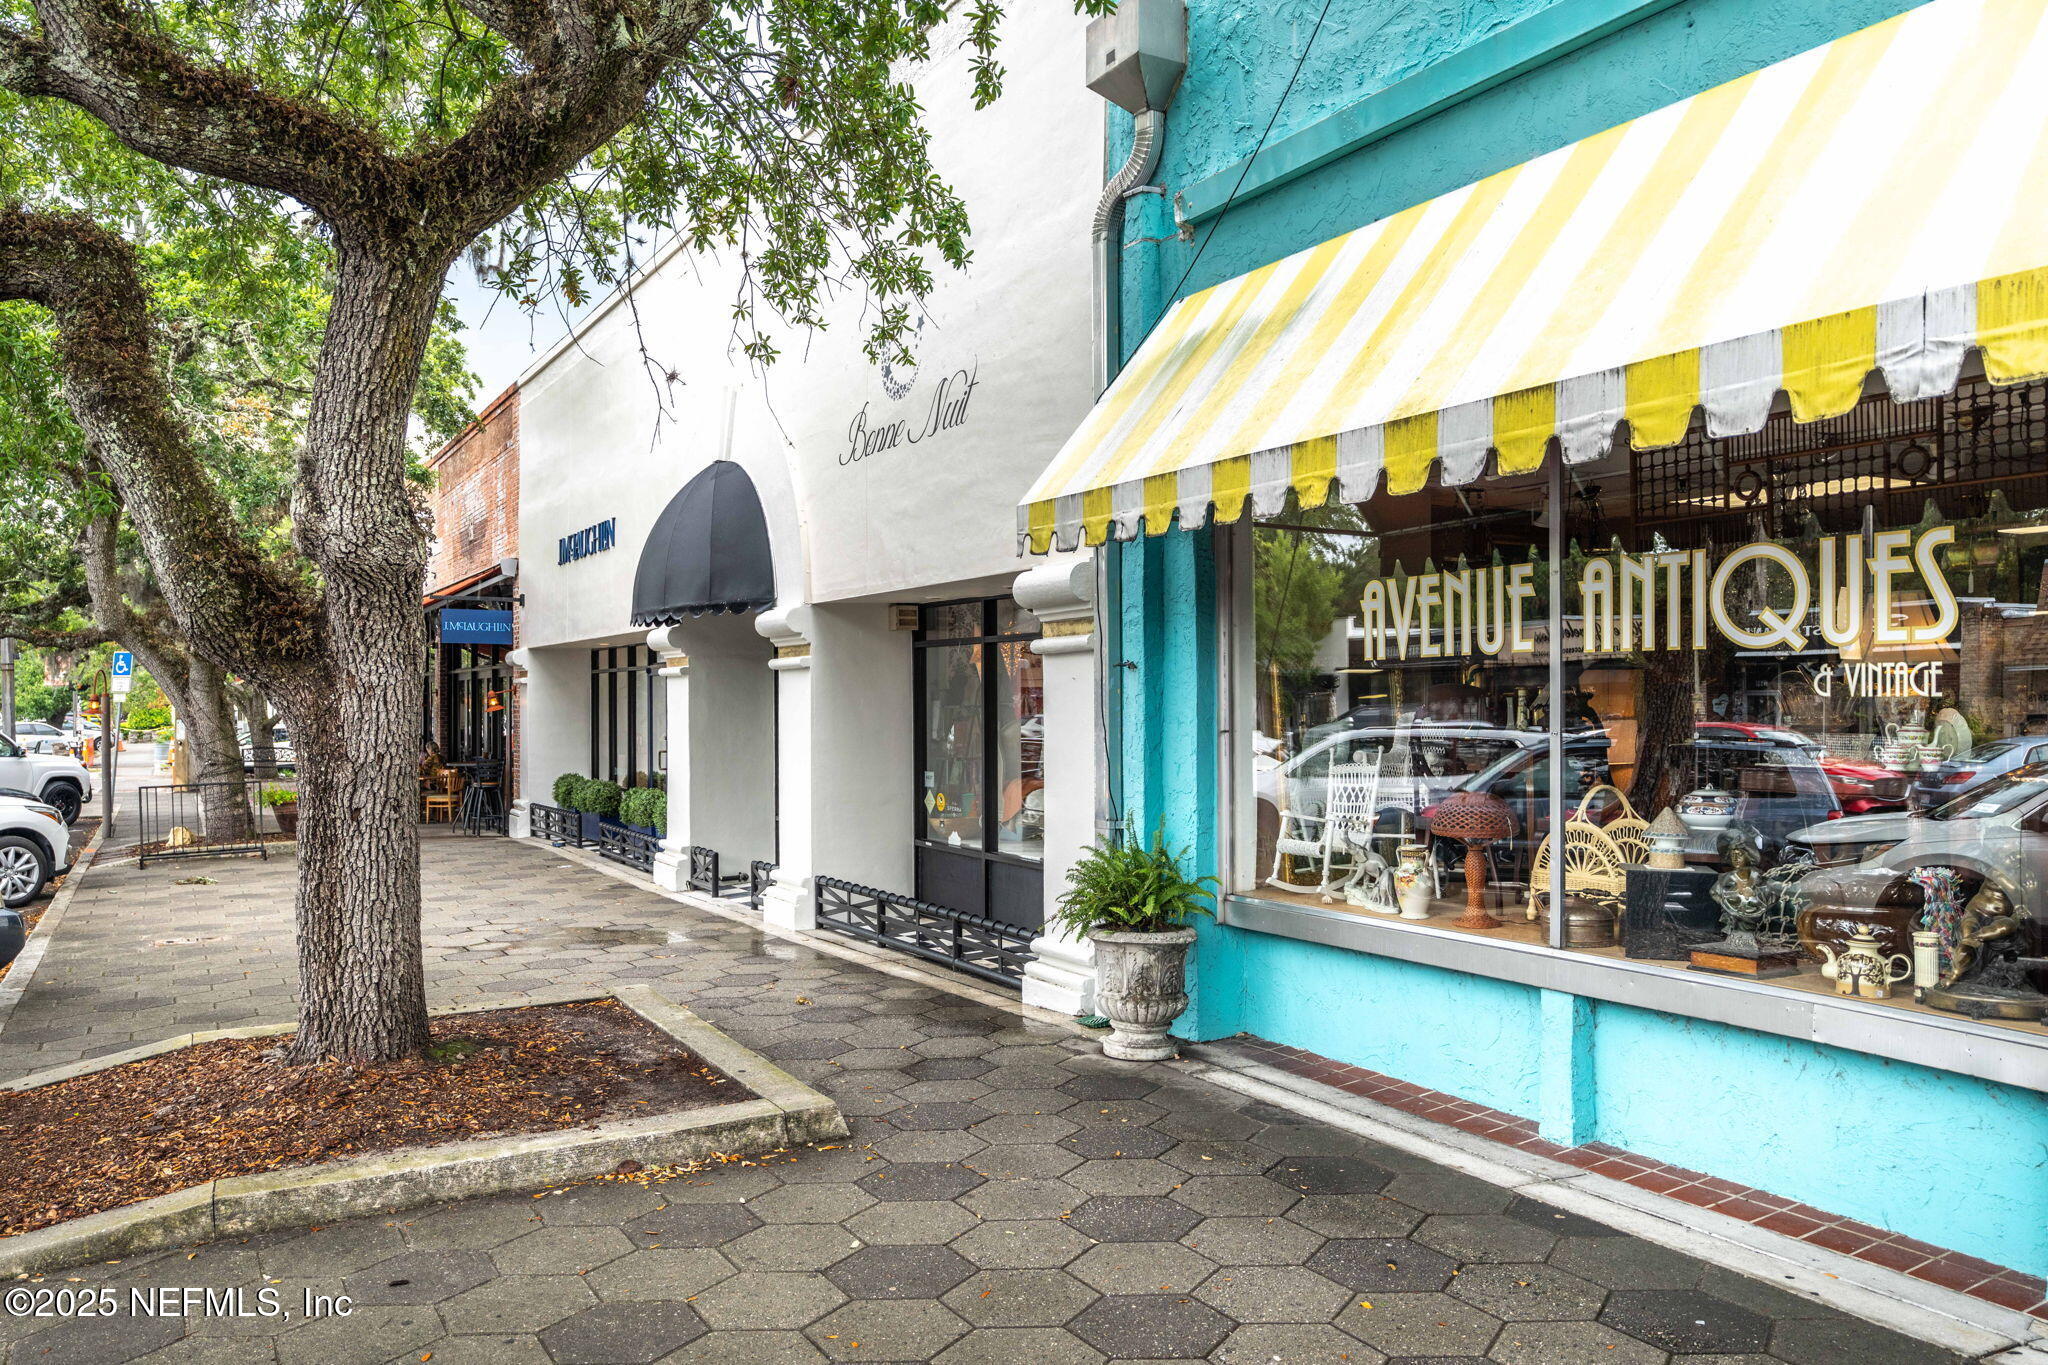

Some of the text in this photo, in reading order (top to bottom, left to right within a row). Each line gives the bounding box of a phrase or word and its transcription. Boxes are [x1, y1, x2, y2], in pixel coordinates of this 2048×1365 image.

[839, 354, 980, 466] Bonne Nuit
[1360, 525, 1958, 662] AVENUE ANTIQUES
[1813, 661, 1945, 699] & VINTAGE
